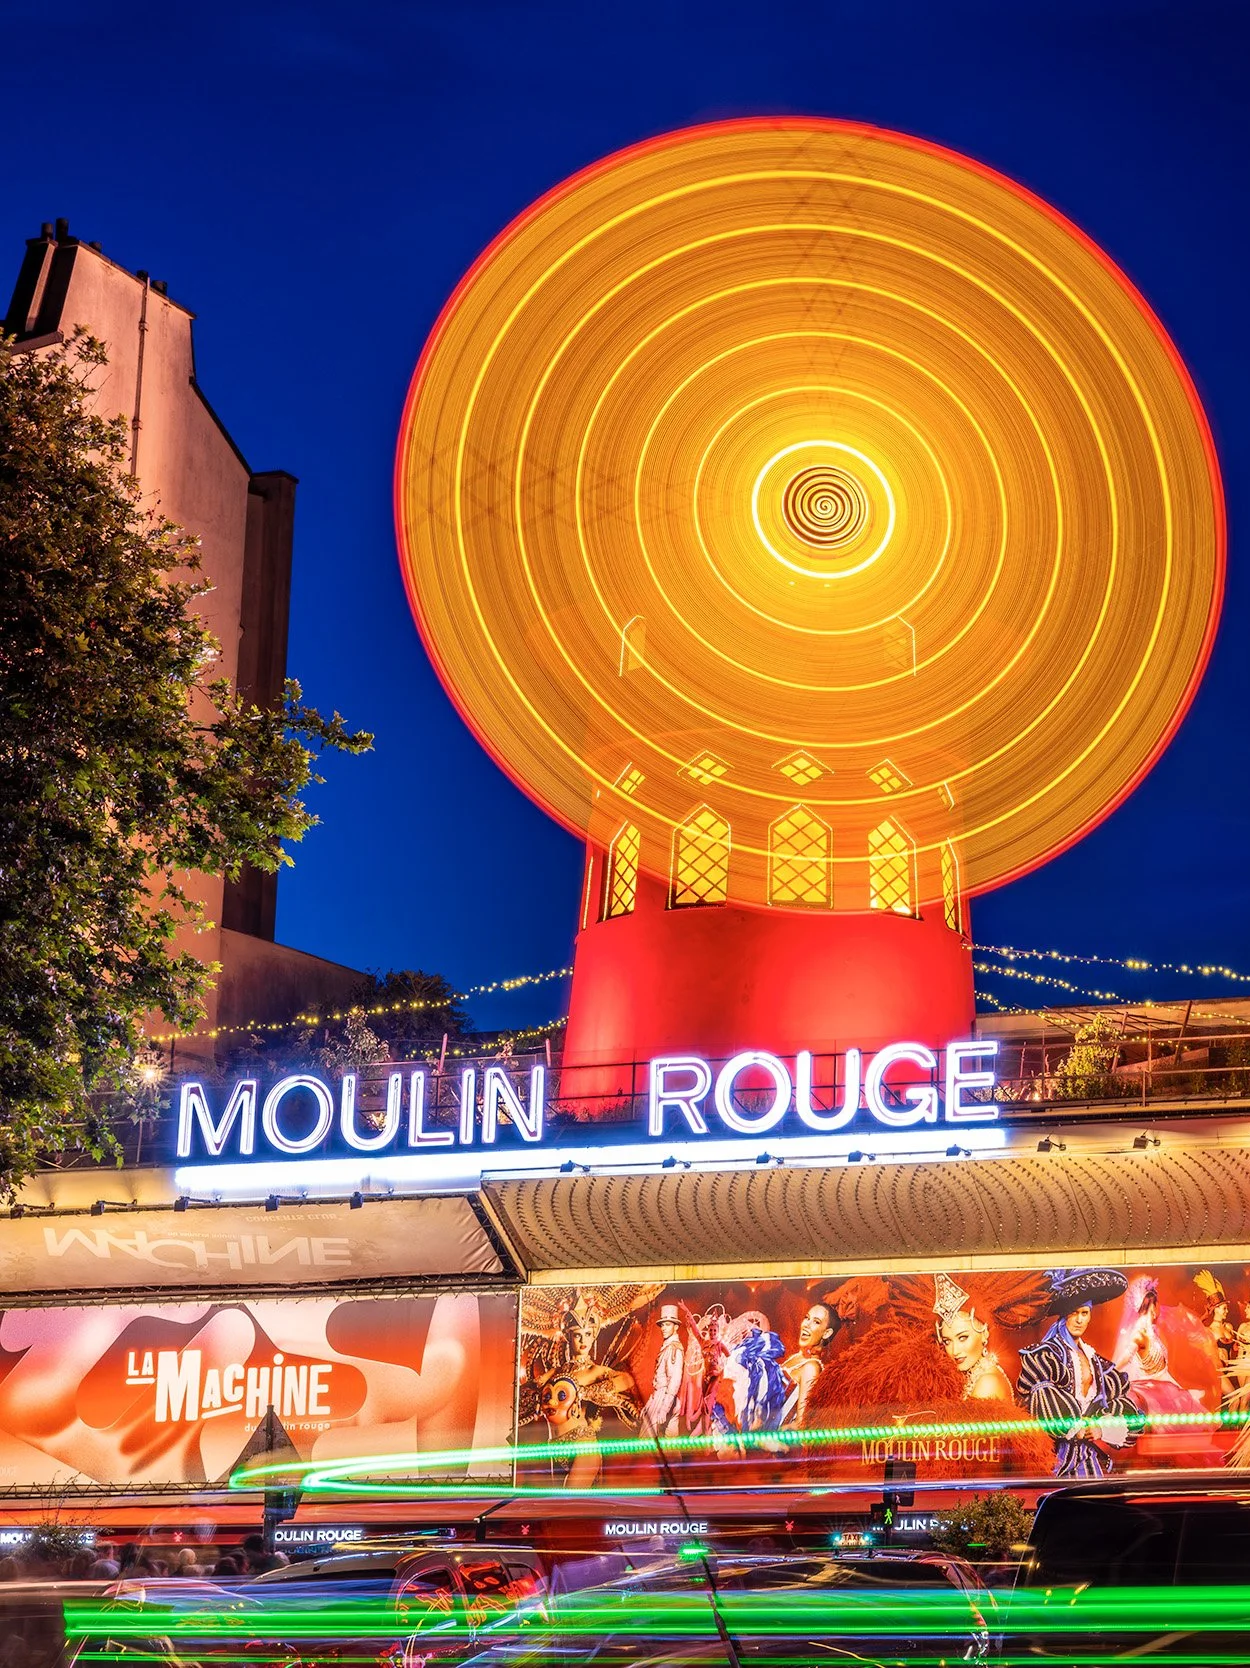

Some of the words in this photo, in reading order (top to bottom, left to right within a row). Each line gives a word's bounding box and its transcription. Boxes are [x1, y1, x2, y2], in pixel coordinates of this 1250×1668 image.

[176, 1064, 545, 1158] MOULIN
[648, 1040, 1000, 1137] ROUGE
[127, 1351, 154, 1376] LA
[299, 1422, 331, 1432] rouge
[860, 1438, 930, 1466] MOULIN
[934, 1435, 1000, 1464] ROUGE
[274, 1530, 314, 1541] OULIN
[316, 1530, 363, 1541] ROUGE
[605, 1523, 657, 1535] MOULIN
[660, 1522, 708, 1534] ROUGE
